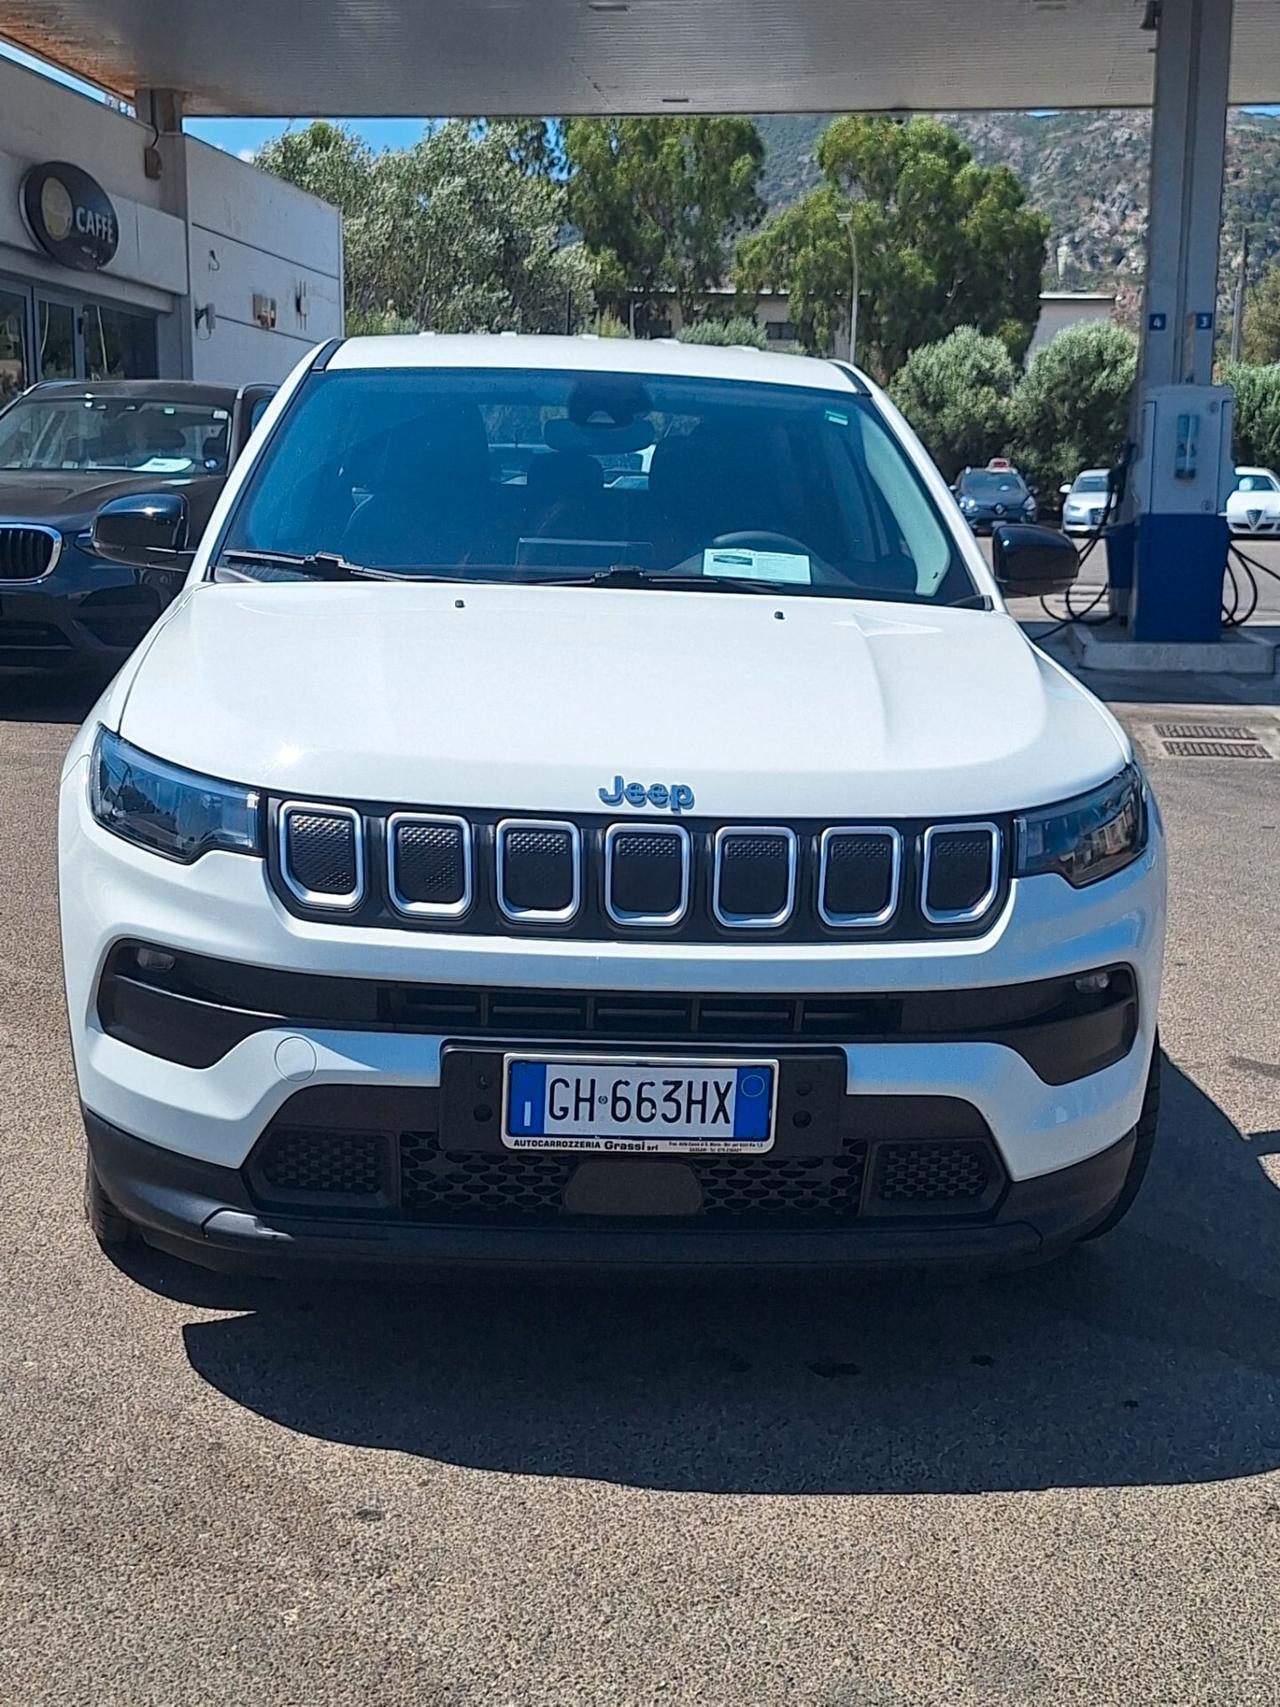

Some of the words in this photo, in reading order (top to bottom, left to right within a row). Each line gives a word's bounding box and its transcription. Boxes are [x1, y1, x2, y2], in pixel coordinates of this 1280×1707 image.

[1153, 316, 1161, 328] 4
[1200, 315, 1207, 328] 3
[598, 775, 695, 815] Jeep
[513, 1139, 601, 1149] AUTOCARROZZERIA
[604, 1140, 645, 1151] Grassi
